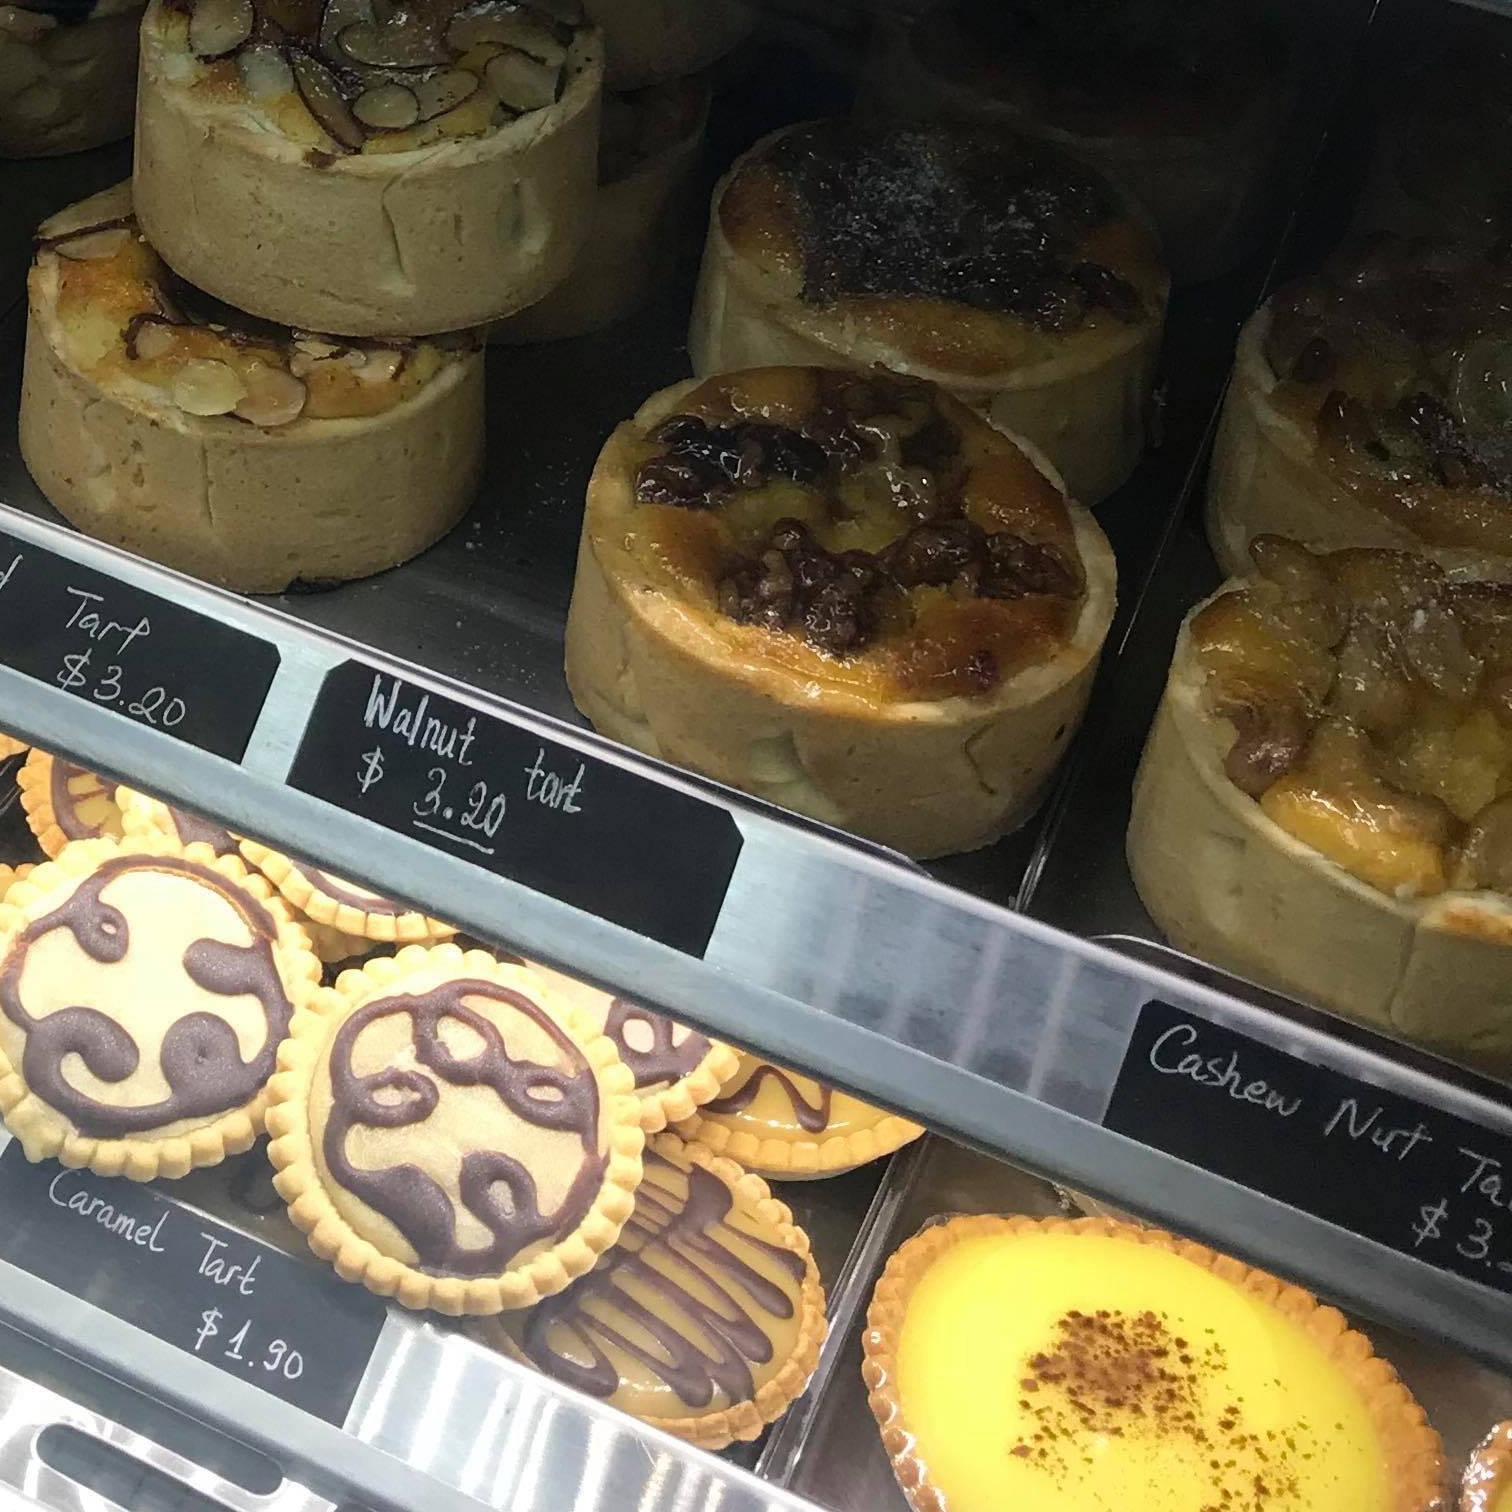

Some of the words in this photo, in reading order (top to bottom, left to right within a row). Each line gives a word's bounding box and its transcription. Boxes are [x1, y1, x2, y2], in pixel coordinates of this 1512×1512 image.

[363, 673, 477, 767] Walnut
[524, 748, 586, 815] tart
[1148, 1023, 1303, 1118] Cashew
[1323, 1097, 1434, 1162] Nut
[1458, 1145, 1512, 1210] Ta
[48, 1168, 171, 1253] Caramel
[199, 1231, 263, 1295] Tart
